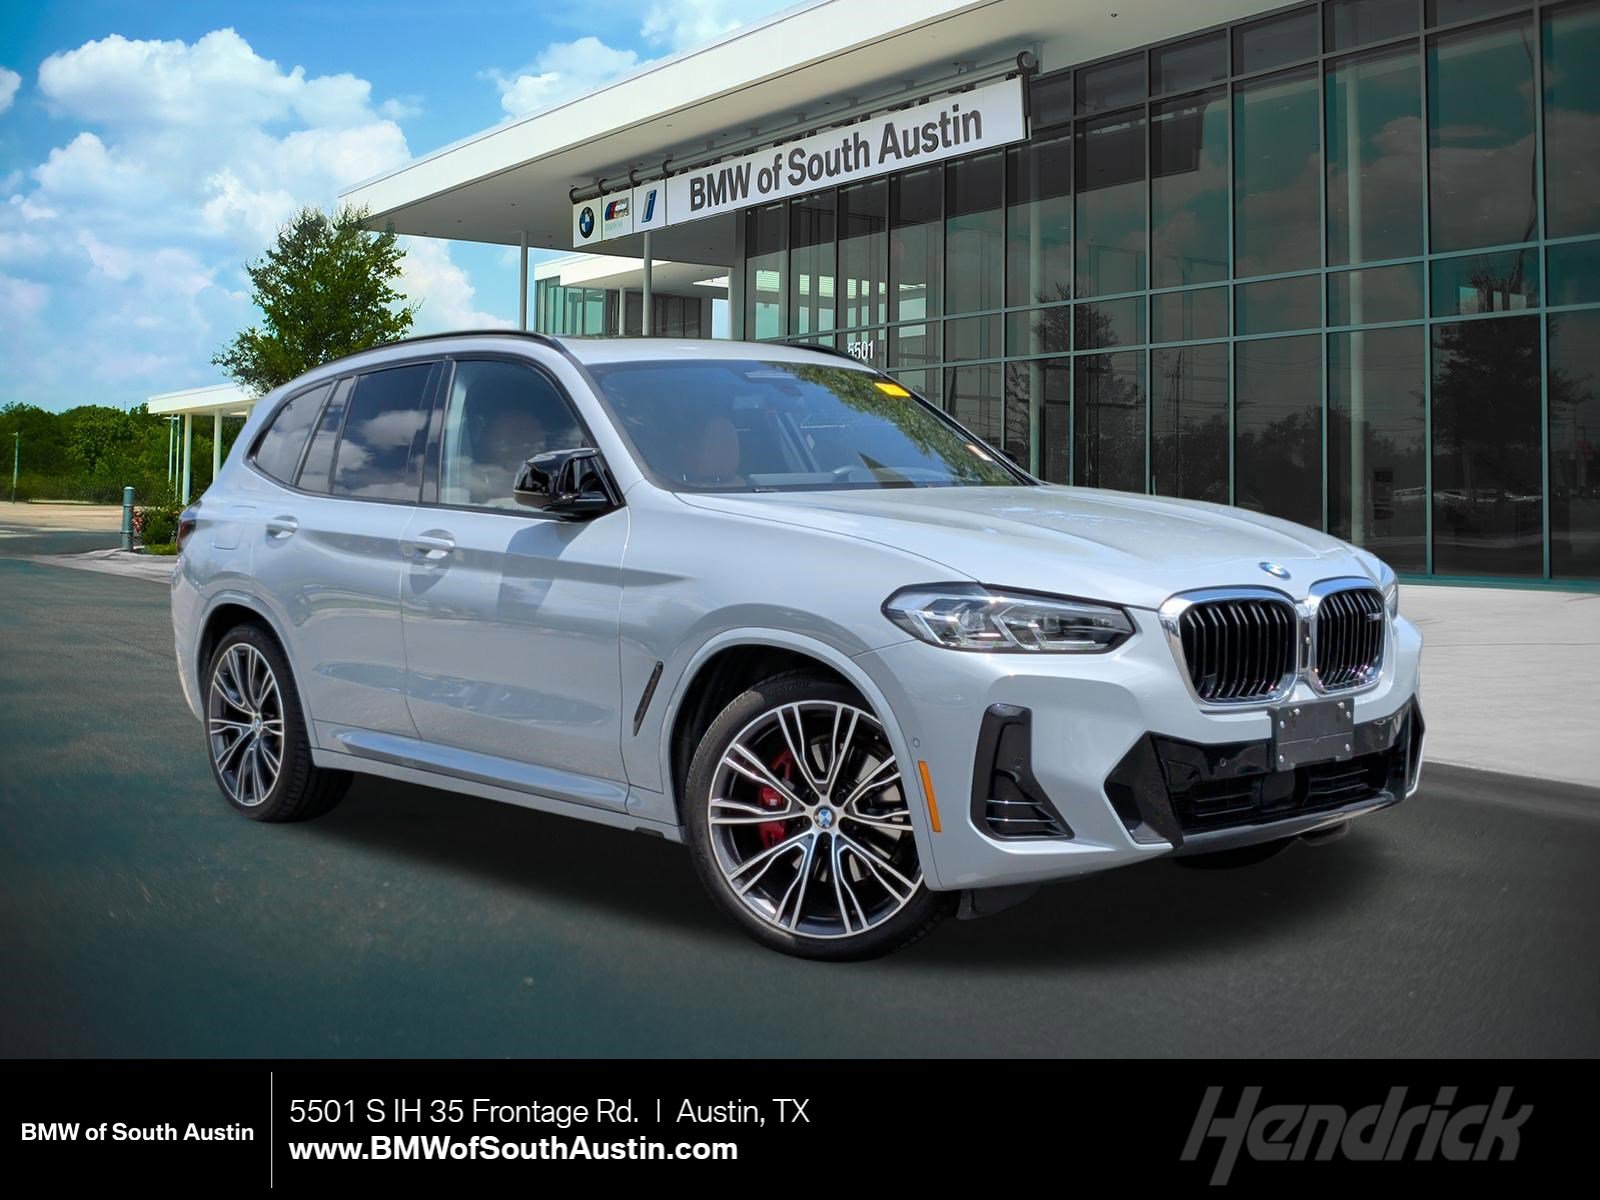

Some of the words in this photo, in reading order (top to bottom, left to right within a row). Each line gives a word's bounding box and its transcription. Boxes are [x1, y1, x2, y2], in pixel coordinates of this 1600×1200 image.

[690, 162, 751, 212] BMW
[757, 153, 782, 194] of
[787, 132, 870, 187] South
[878, 103, 982, 165] Austin
[847, 340, 874, 360] 5501
